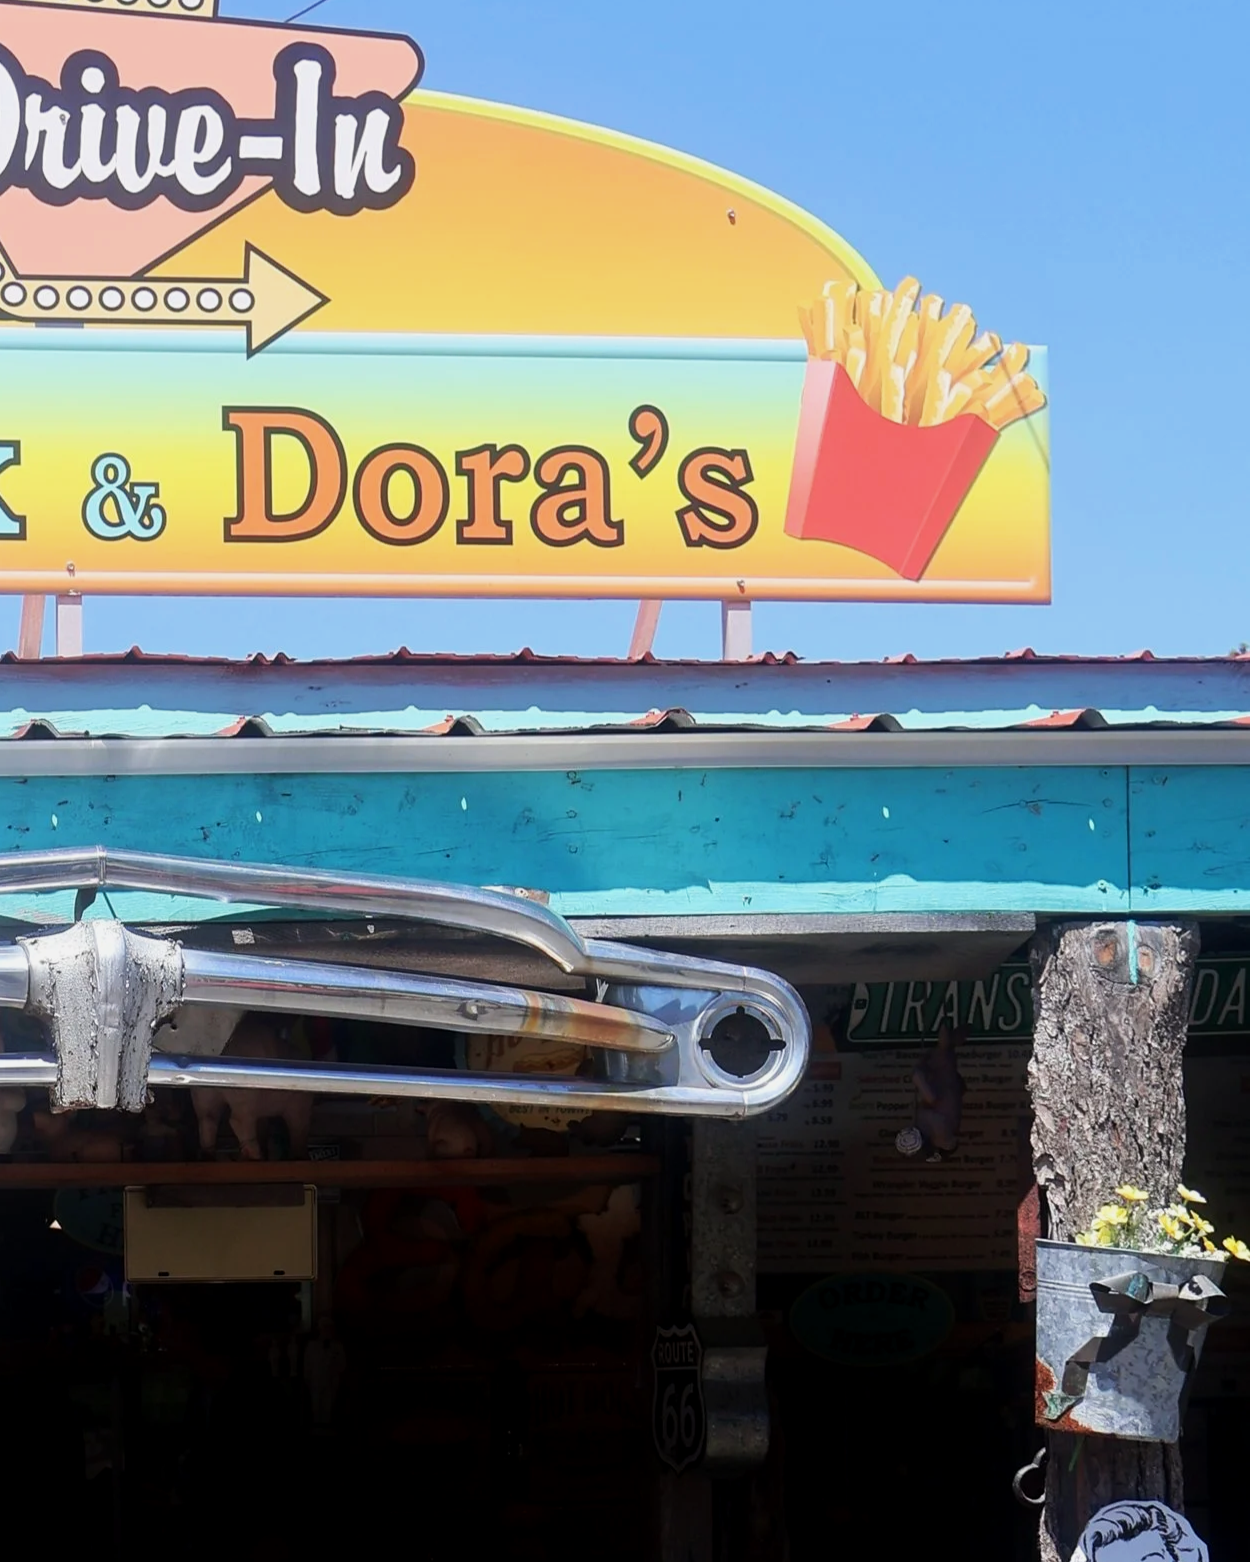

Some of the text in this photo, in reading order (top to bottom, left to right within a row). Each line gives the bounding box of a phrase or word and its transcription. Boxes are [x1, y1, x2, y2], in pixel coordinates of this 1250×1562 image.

[81, 452, 167, 541] &
[221, 404, 759, 550] Dora's
[658, 1341, 694, 1365] ROUTE
[661, 1382, 698, 1448] 66
